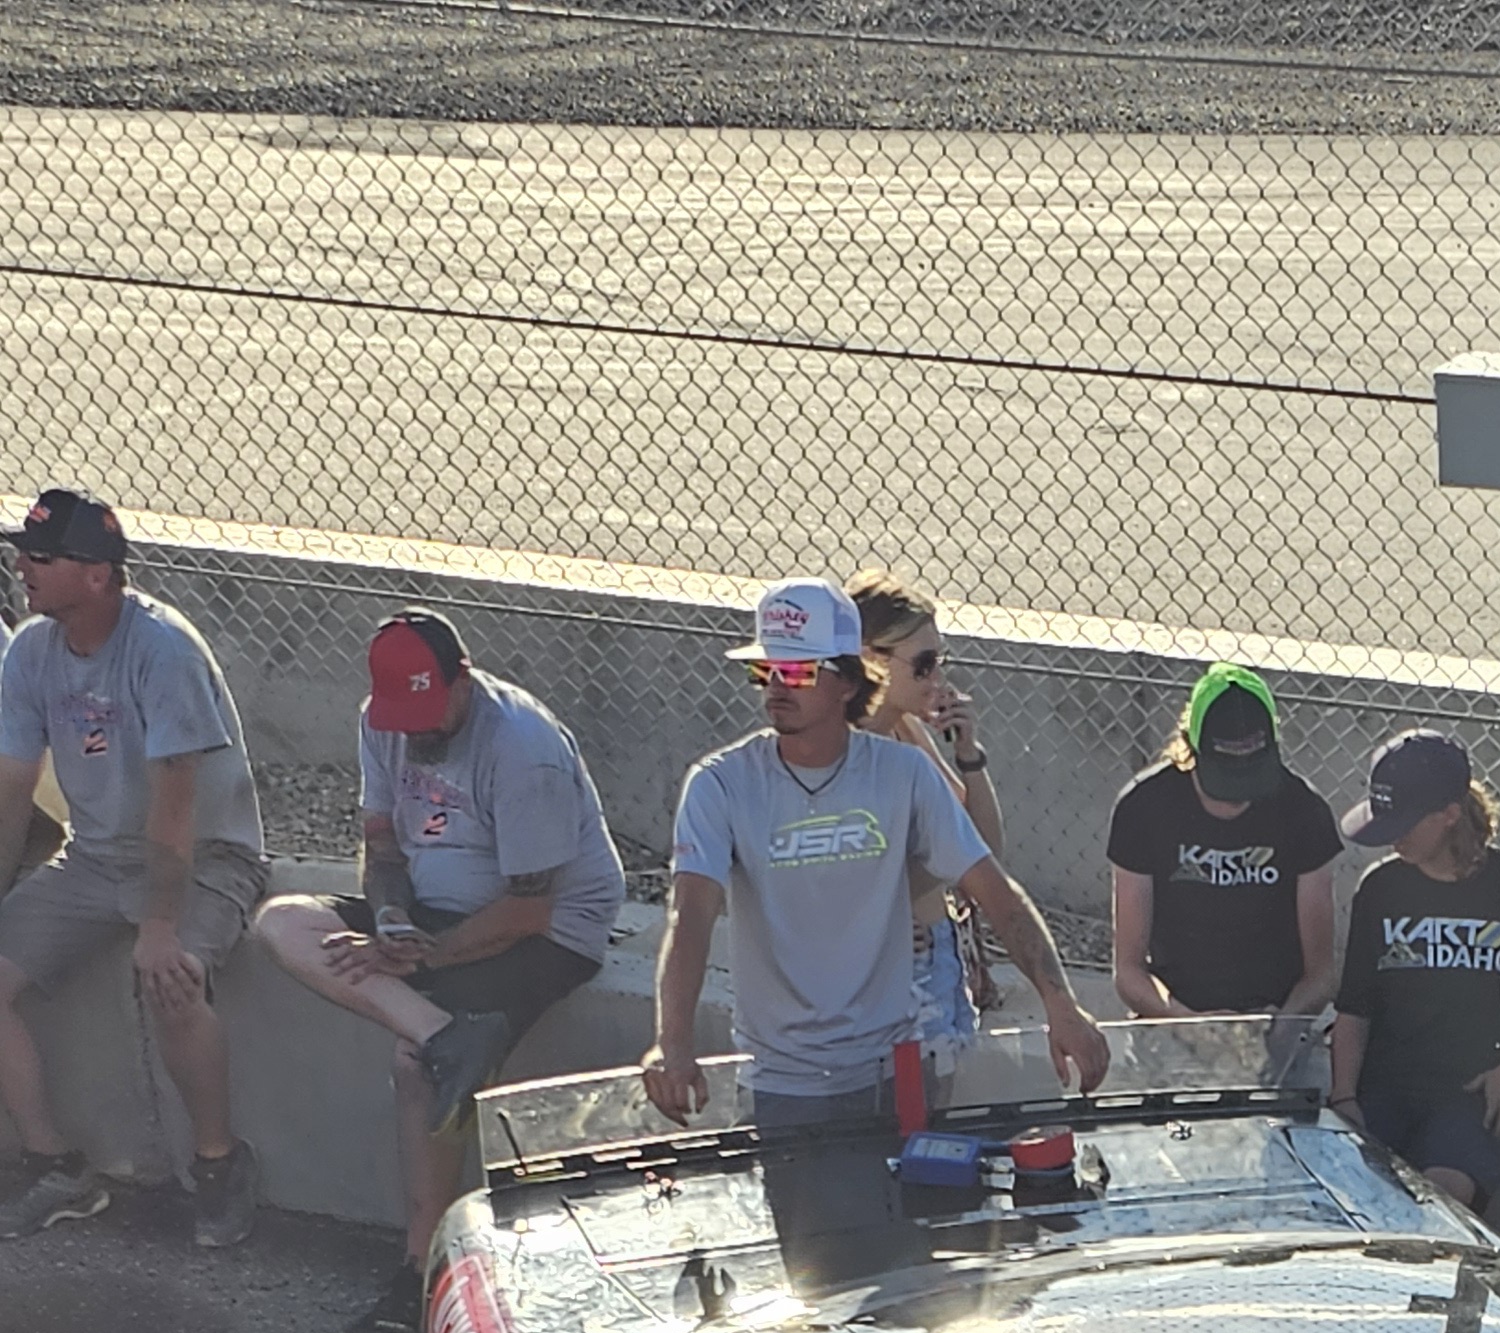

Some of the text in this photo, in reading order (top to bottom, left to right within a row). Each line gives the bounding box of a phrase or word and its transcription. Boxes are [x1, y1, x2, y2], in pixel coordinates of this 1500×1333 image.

[769, 824, 867, 861] JSR
[1179, 844, 1254, 869] KART
[1211, 866, 1280, 886] IDAHO
[1383, 916, 1488, 946] KART
